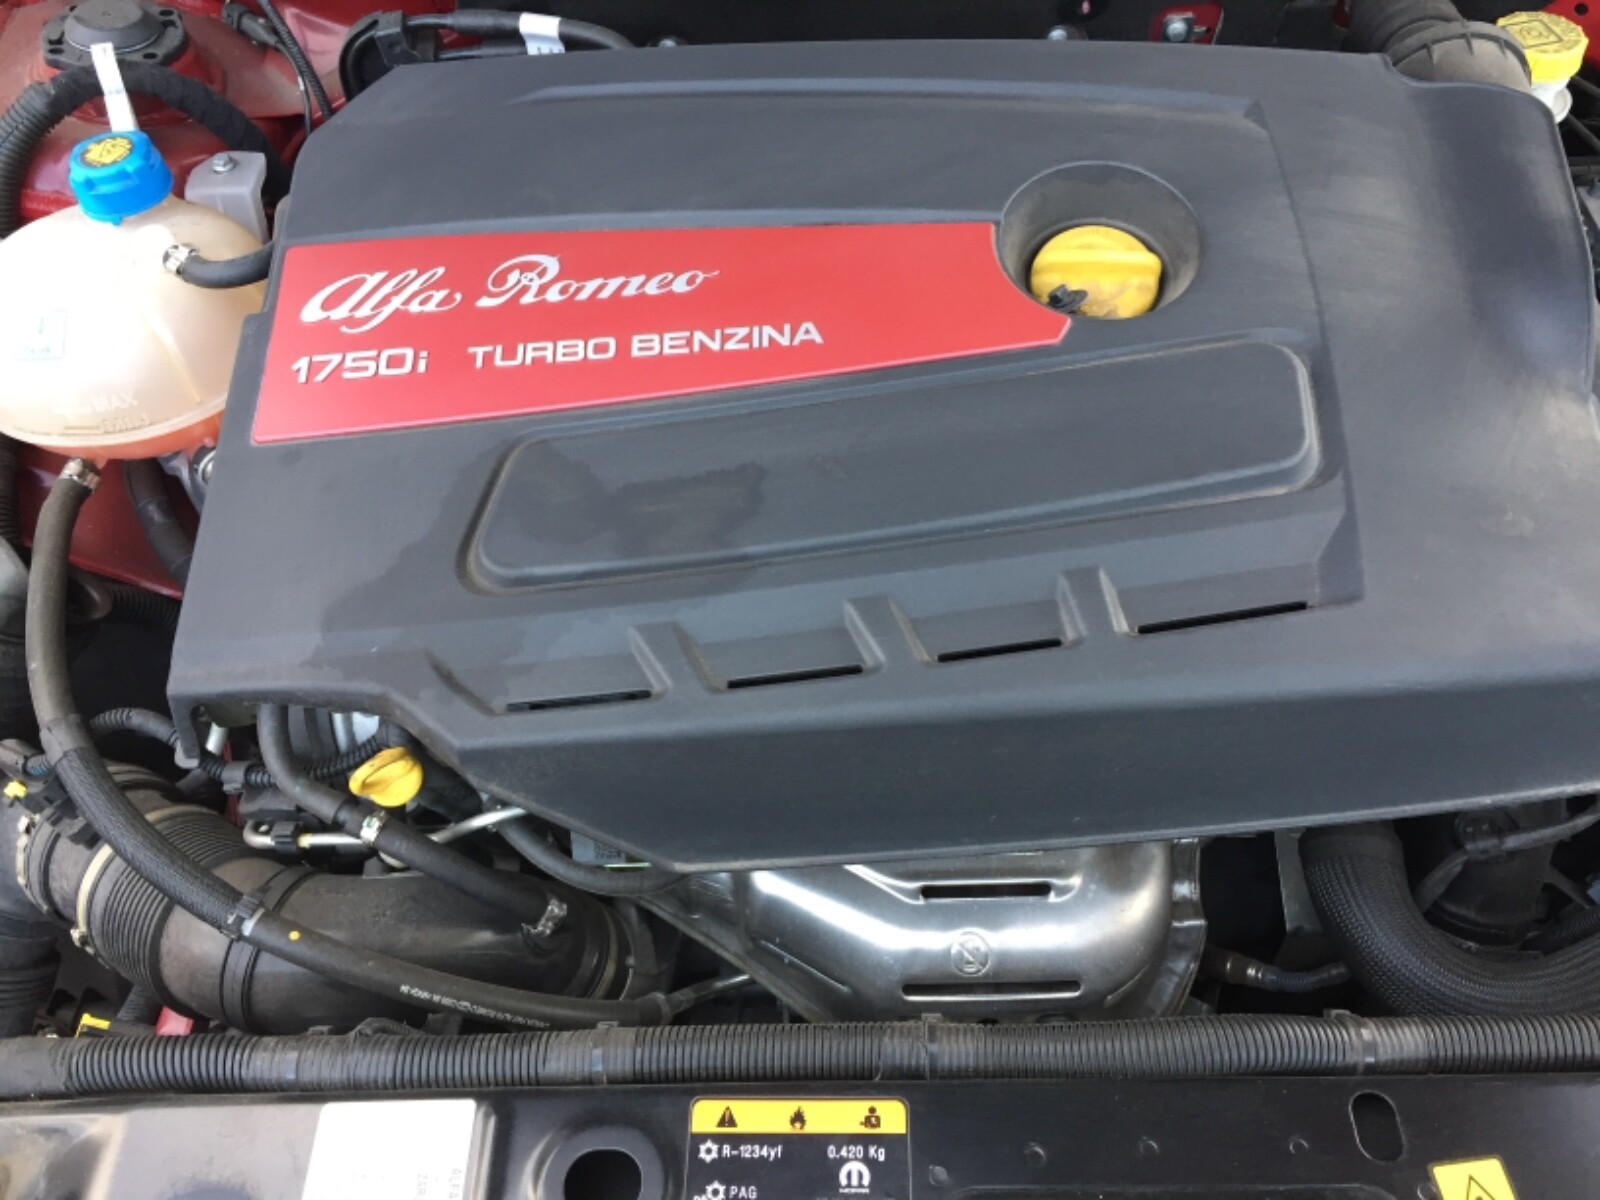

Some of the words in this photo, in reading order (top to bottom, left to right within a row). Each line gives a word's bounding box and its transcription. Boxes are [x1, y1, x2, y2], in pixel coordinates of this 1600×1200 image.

[299, 265, 464, 334] Alfa
[475, 253, 720, 309] Romeo
[290, 346, 429, 384] 1750i
[467, 336, 617, 370] TURBO
[630, 321, 824, 358] BENZINA
[720, 1144, 783, 1161] R-1234yf
[827, 1145, 864, 1160] 0.420
[868, 1145, 886, 1162] Kg
[729, 1186, 758, 1199] PAG
